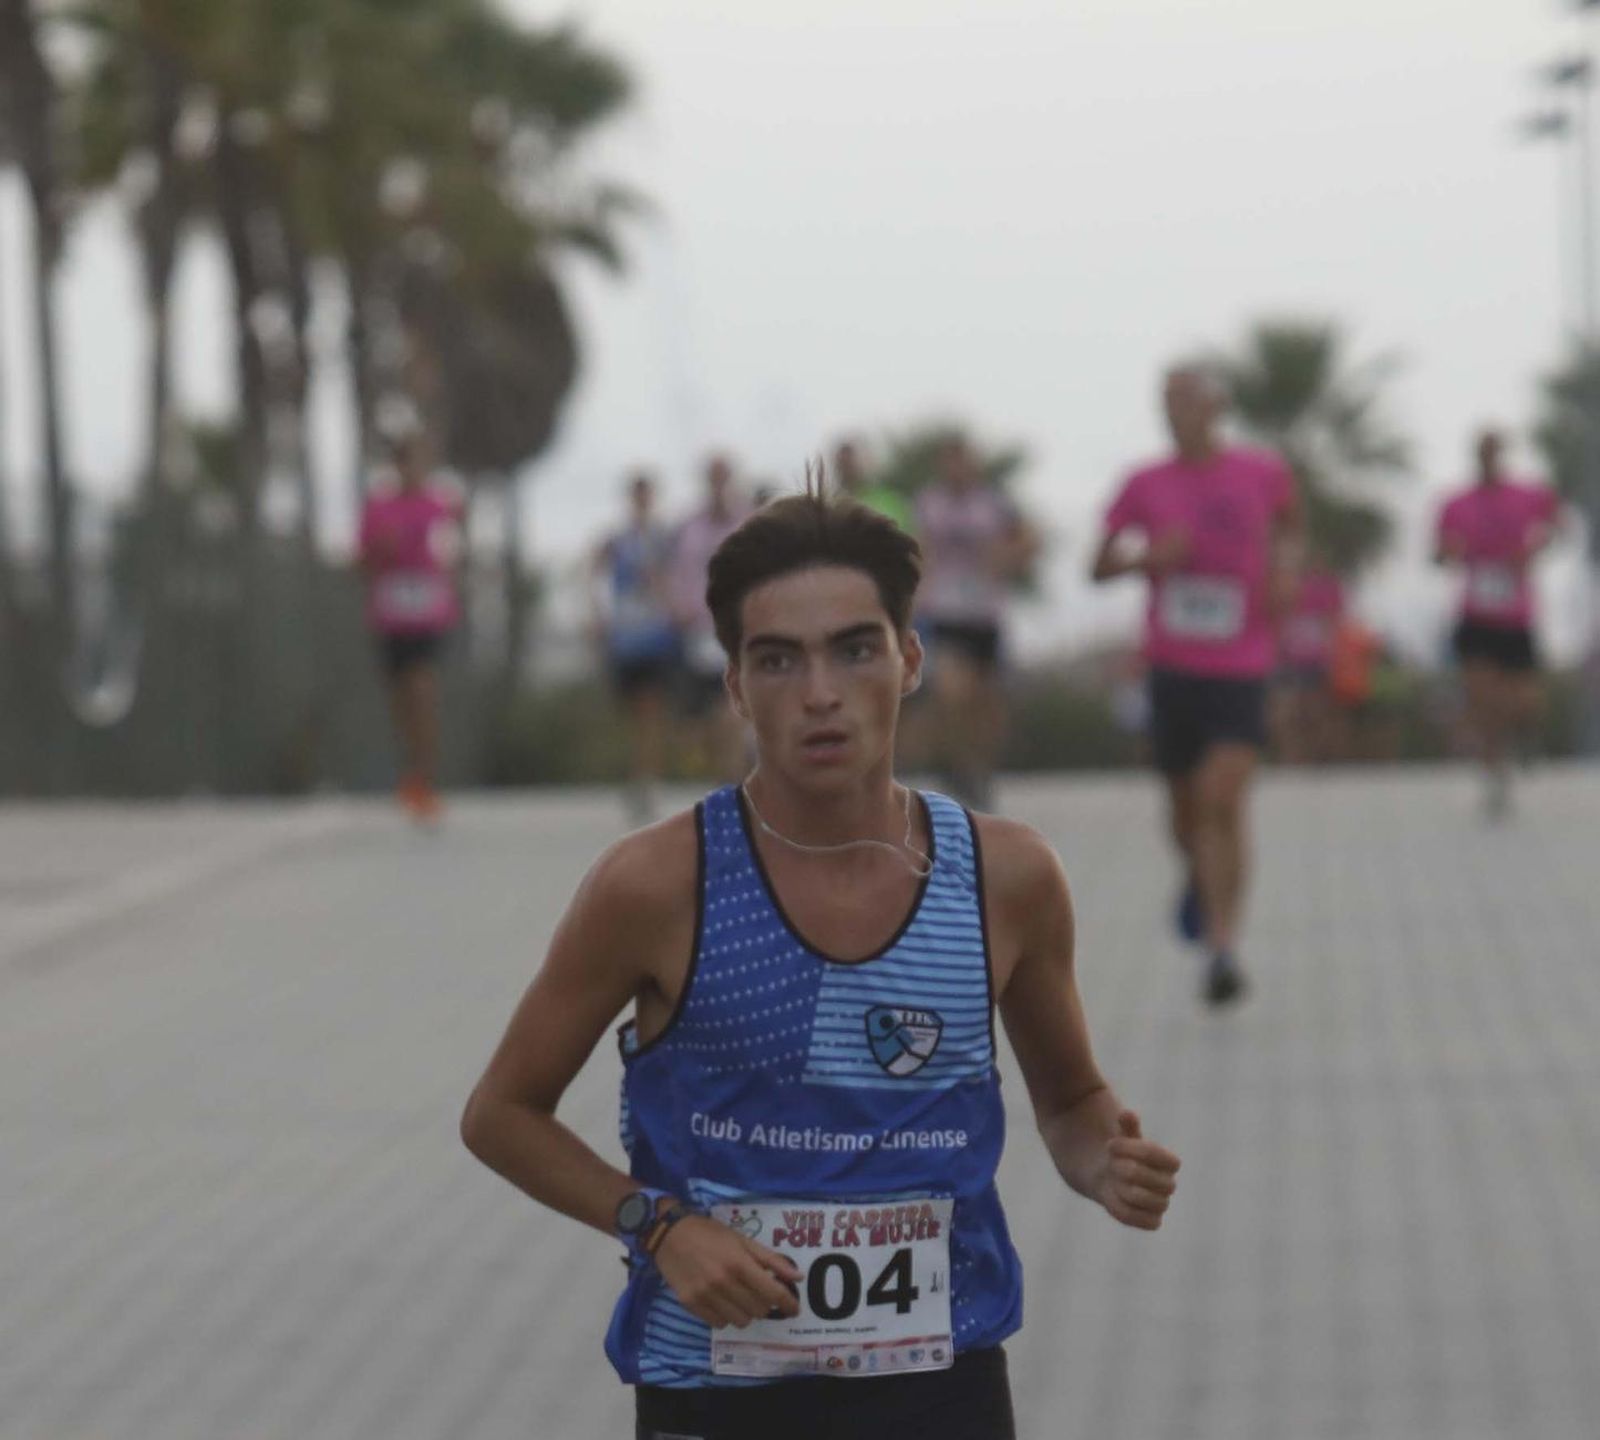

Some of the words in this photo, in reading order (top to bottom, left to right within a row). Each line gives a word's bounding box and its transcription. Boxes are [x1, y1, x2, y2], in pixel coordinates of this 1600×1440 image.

[691, 1112, 742, 1142] Club
[749, 1124, 874, 1151] Atletismo
[881, 1128, 969, 1149] Linense
[773, 1226, 823, 1248] POR
[831, 1224, 861, 1248] LA
[869, 1217, 941, 1247] MUJER
